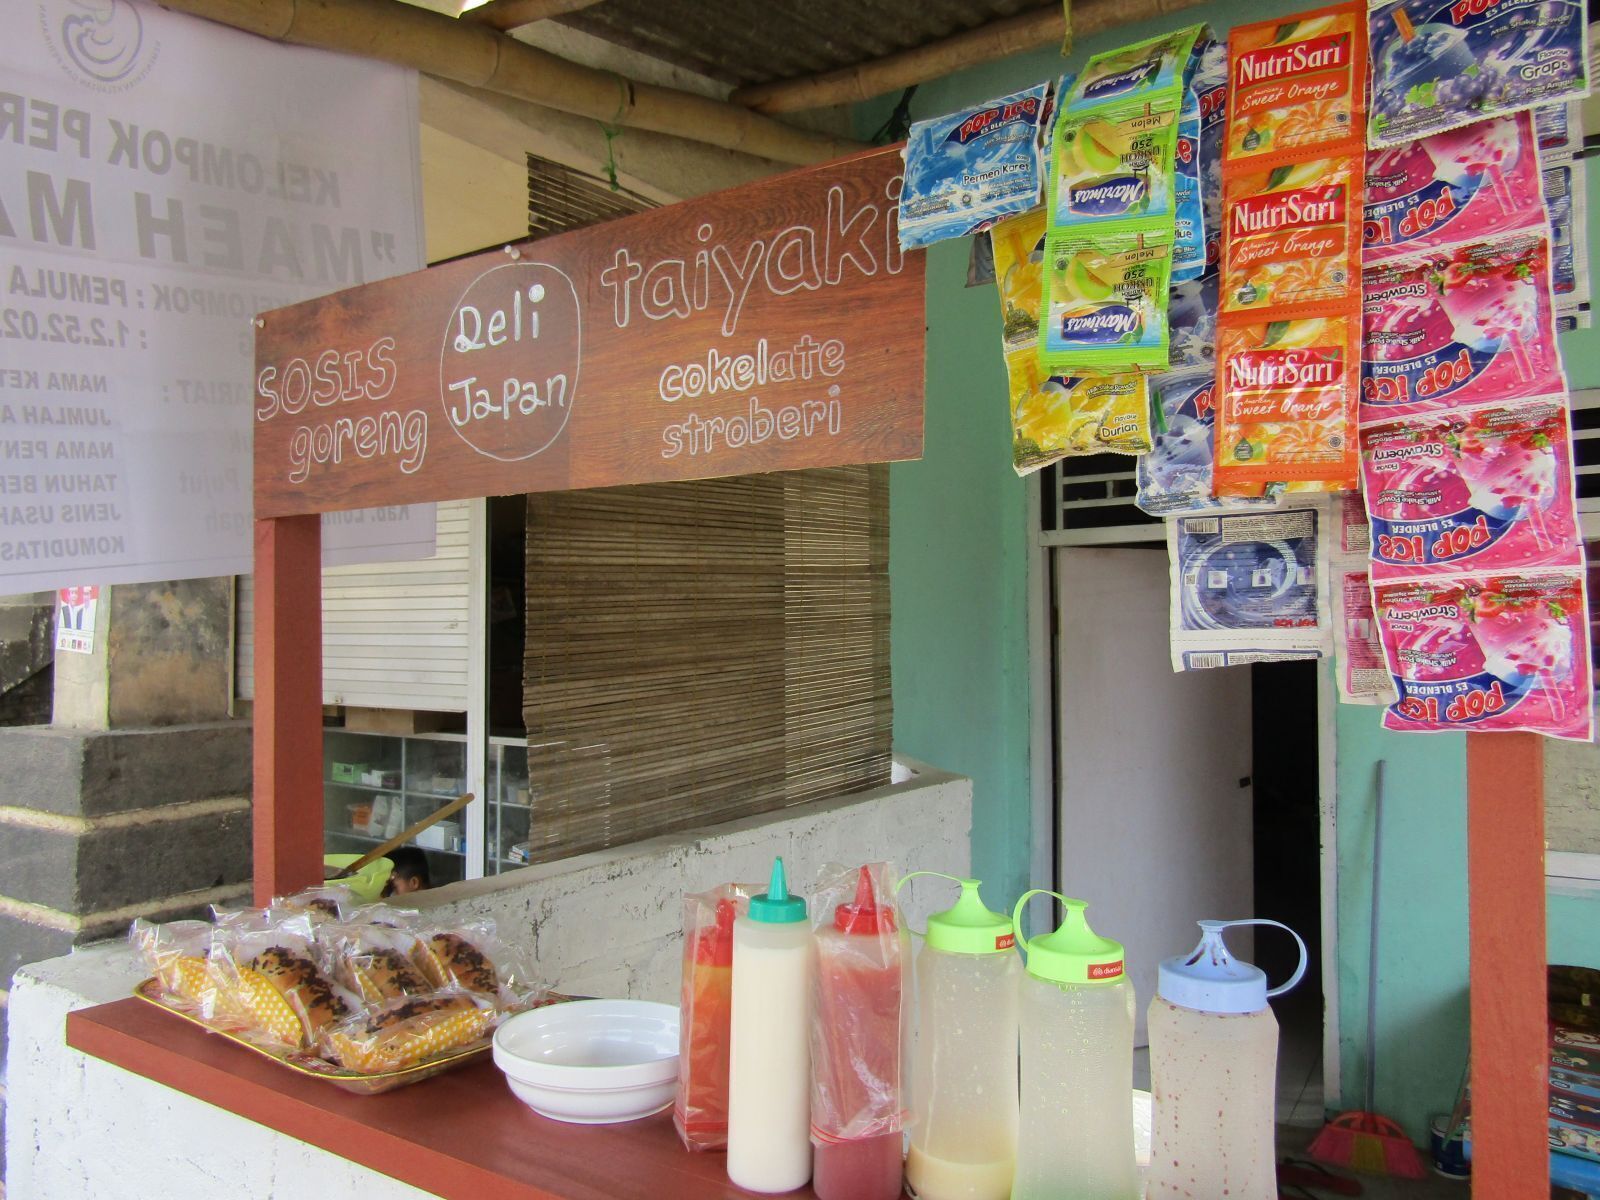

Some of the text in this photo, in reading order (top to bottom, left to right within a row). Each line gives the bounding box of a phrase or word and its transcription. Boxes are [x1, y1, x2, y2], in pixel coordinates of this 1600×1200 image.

[1239, 44, 1341, 86] NutriSari
[1241, 80, 1340, 111] Sweet Orange
[959, 110, 1000, 143] POP
[1131, 116, 1161, 128] Melon
[963, 162, 1030, 185] Permen Karet
[1074, 180, 1145, 203] Marimas
[1234, 194, 1336, 235] NutriSari
[1398, 186, 1456, 237] POP
[601, 176, 904, 337] taiyaki
[1125, 249, 1154, 261] Melon
[1237, 242, 1280, 263] Sweet
[1283, 236, 1335, 256] Orange
[1123, 269, 1145, 280] 250
[1364, 283, 1426, 303] Strawberr
[454, 284, 545, 352] Deli
[1067, 312, 1137, 333] Marimas
[257, 337, 397, 421] SOSIS
[659, 334, 846, 402] cokelate
[1229, 354, 1333, 387] NutriSari
[1415, 349, 1474, 396] POP
[449, 374, 567, 426] Japan
[1233, 398, 1332, 418] Sweet Orange
[661, 385, 841, 458] stroberi
[1102, 424, 1138, 438] Durian
[289, 410, 429, 483] goreng
[1373, 443, 1442, 461] Strawberry
[1392, 519, 1454, 534] ES BLENDER
[1431, 515, 1492, 559] POP
[1387, 605, 1457, 621] Strawberry
[1405, 681, 1468, 695] ES BLENDER
[1445, 681, 1505, 722] POP
